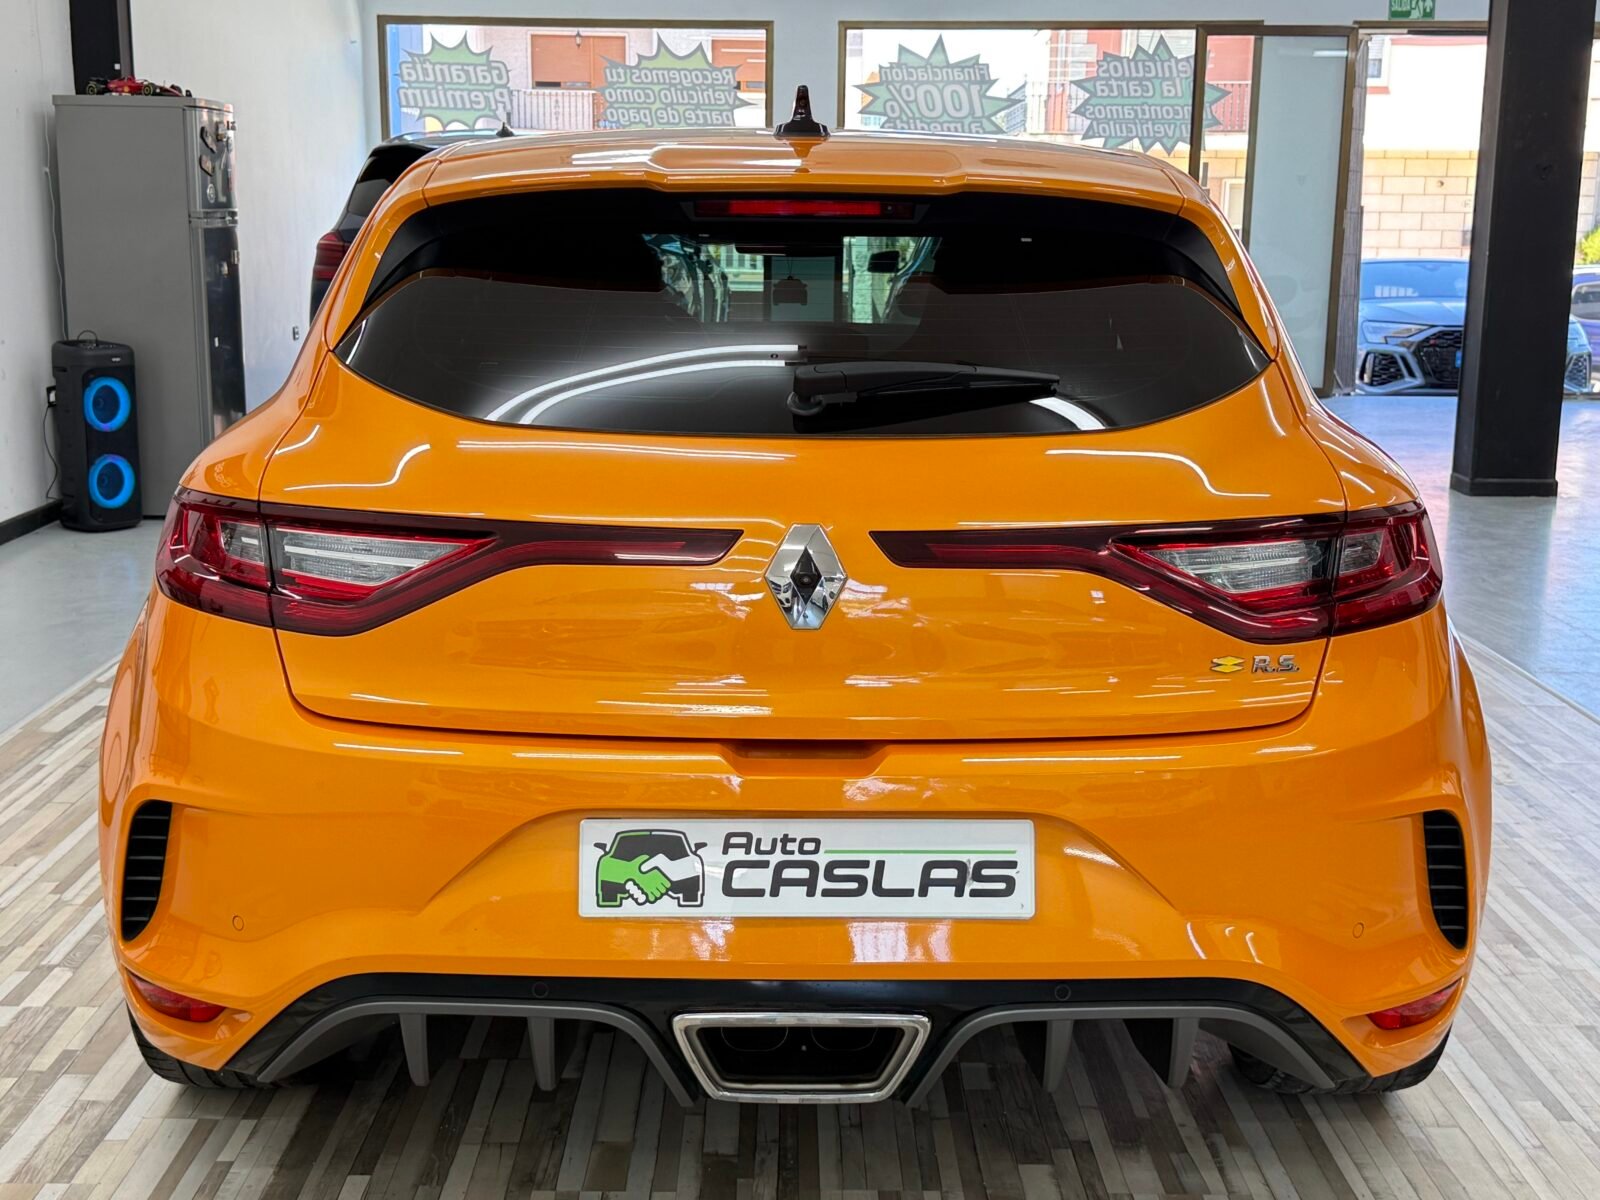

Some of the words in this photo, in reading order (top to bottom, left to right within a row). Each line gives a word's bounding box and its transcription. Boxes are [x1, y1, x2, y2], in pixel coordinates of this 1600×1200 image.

[1252, 654, 1300, 673] R.S.
[721, 832, 821, 855] Auto
[721, 860, 1018, 898] CASLAS
